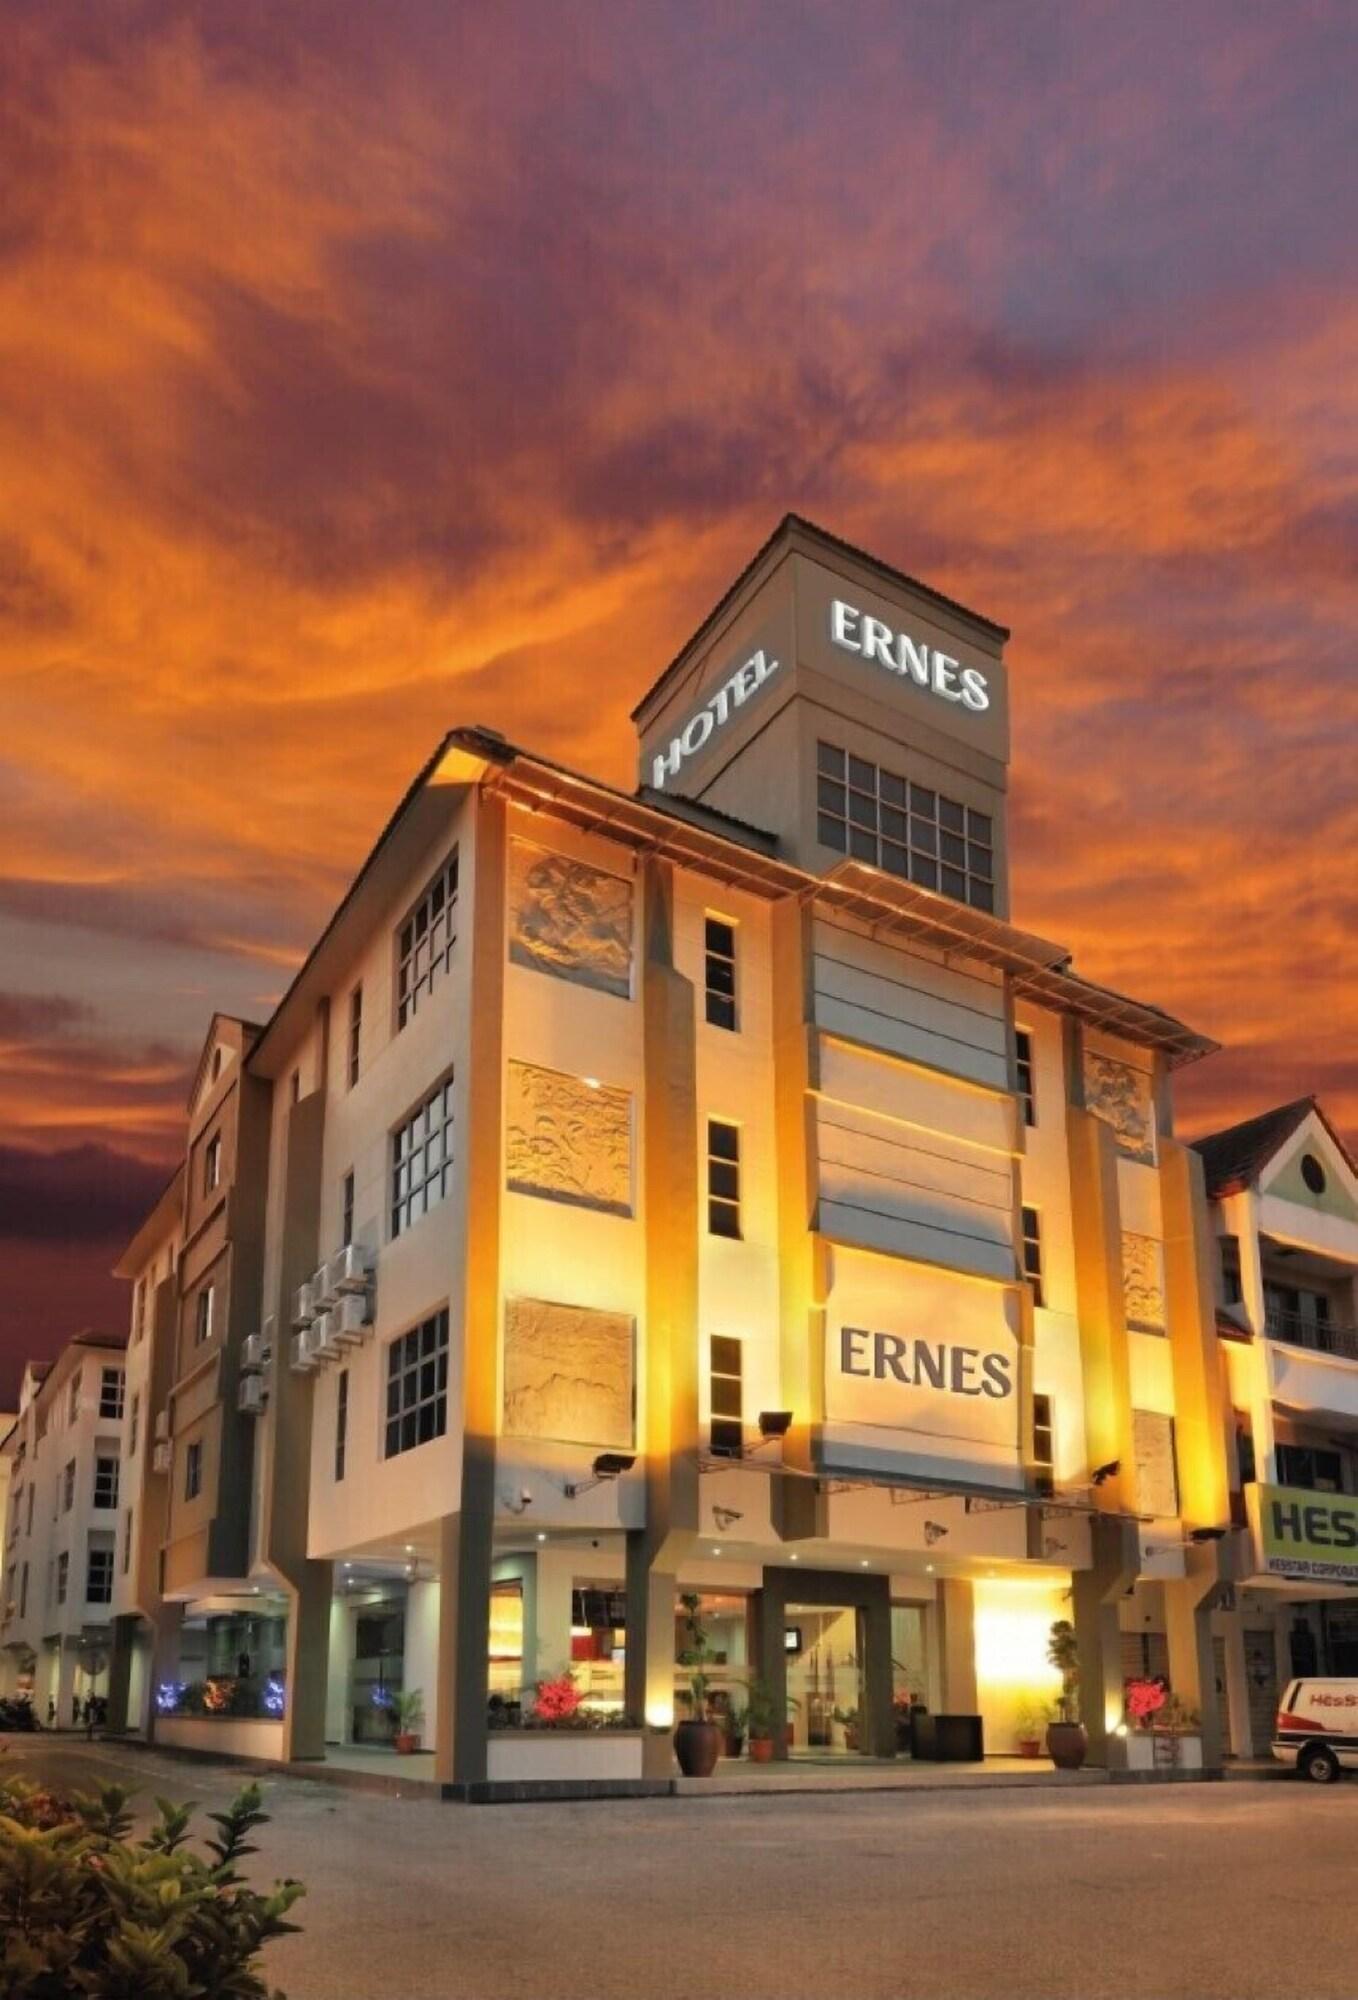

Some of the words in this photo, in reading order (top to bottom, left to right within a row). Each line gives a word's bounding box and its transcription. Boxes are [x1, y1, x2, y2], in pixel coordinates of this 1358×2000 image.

[830, 600, 990, 712] ERNES
[652, 649, 779, 789] HOTEL
[841, 1326, 1012, 1399] ERNES
